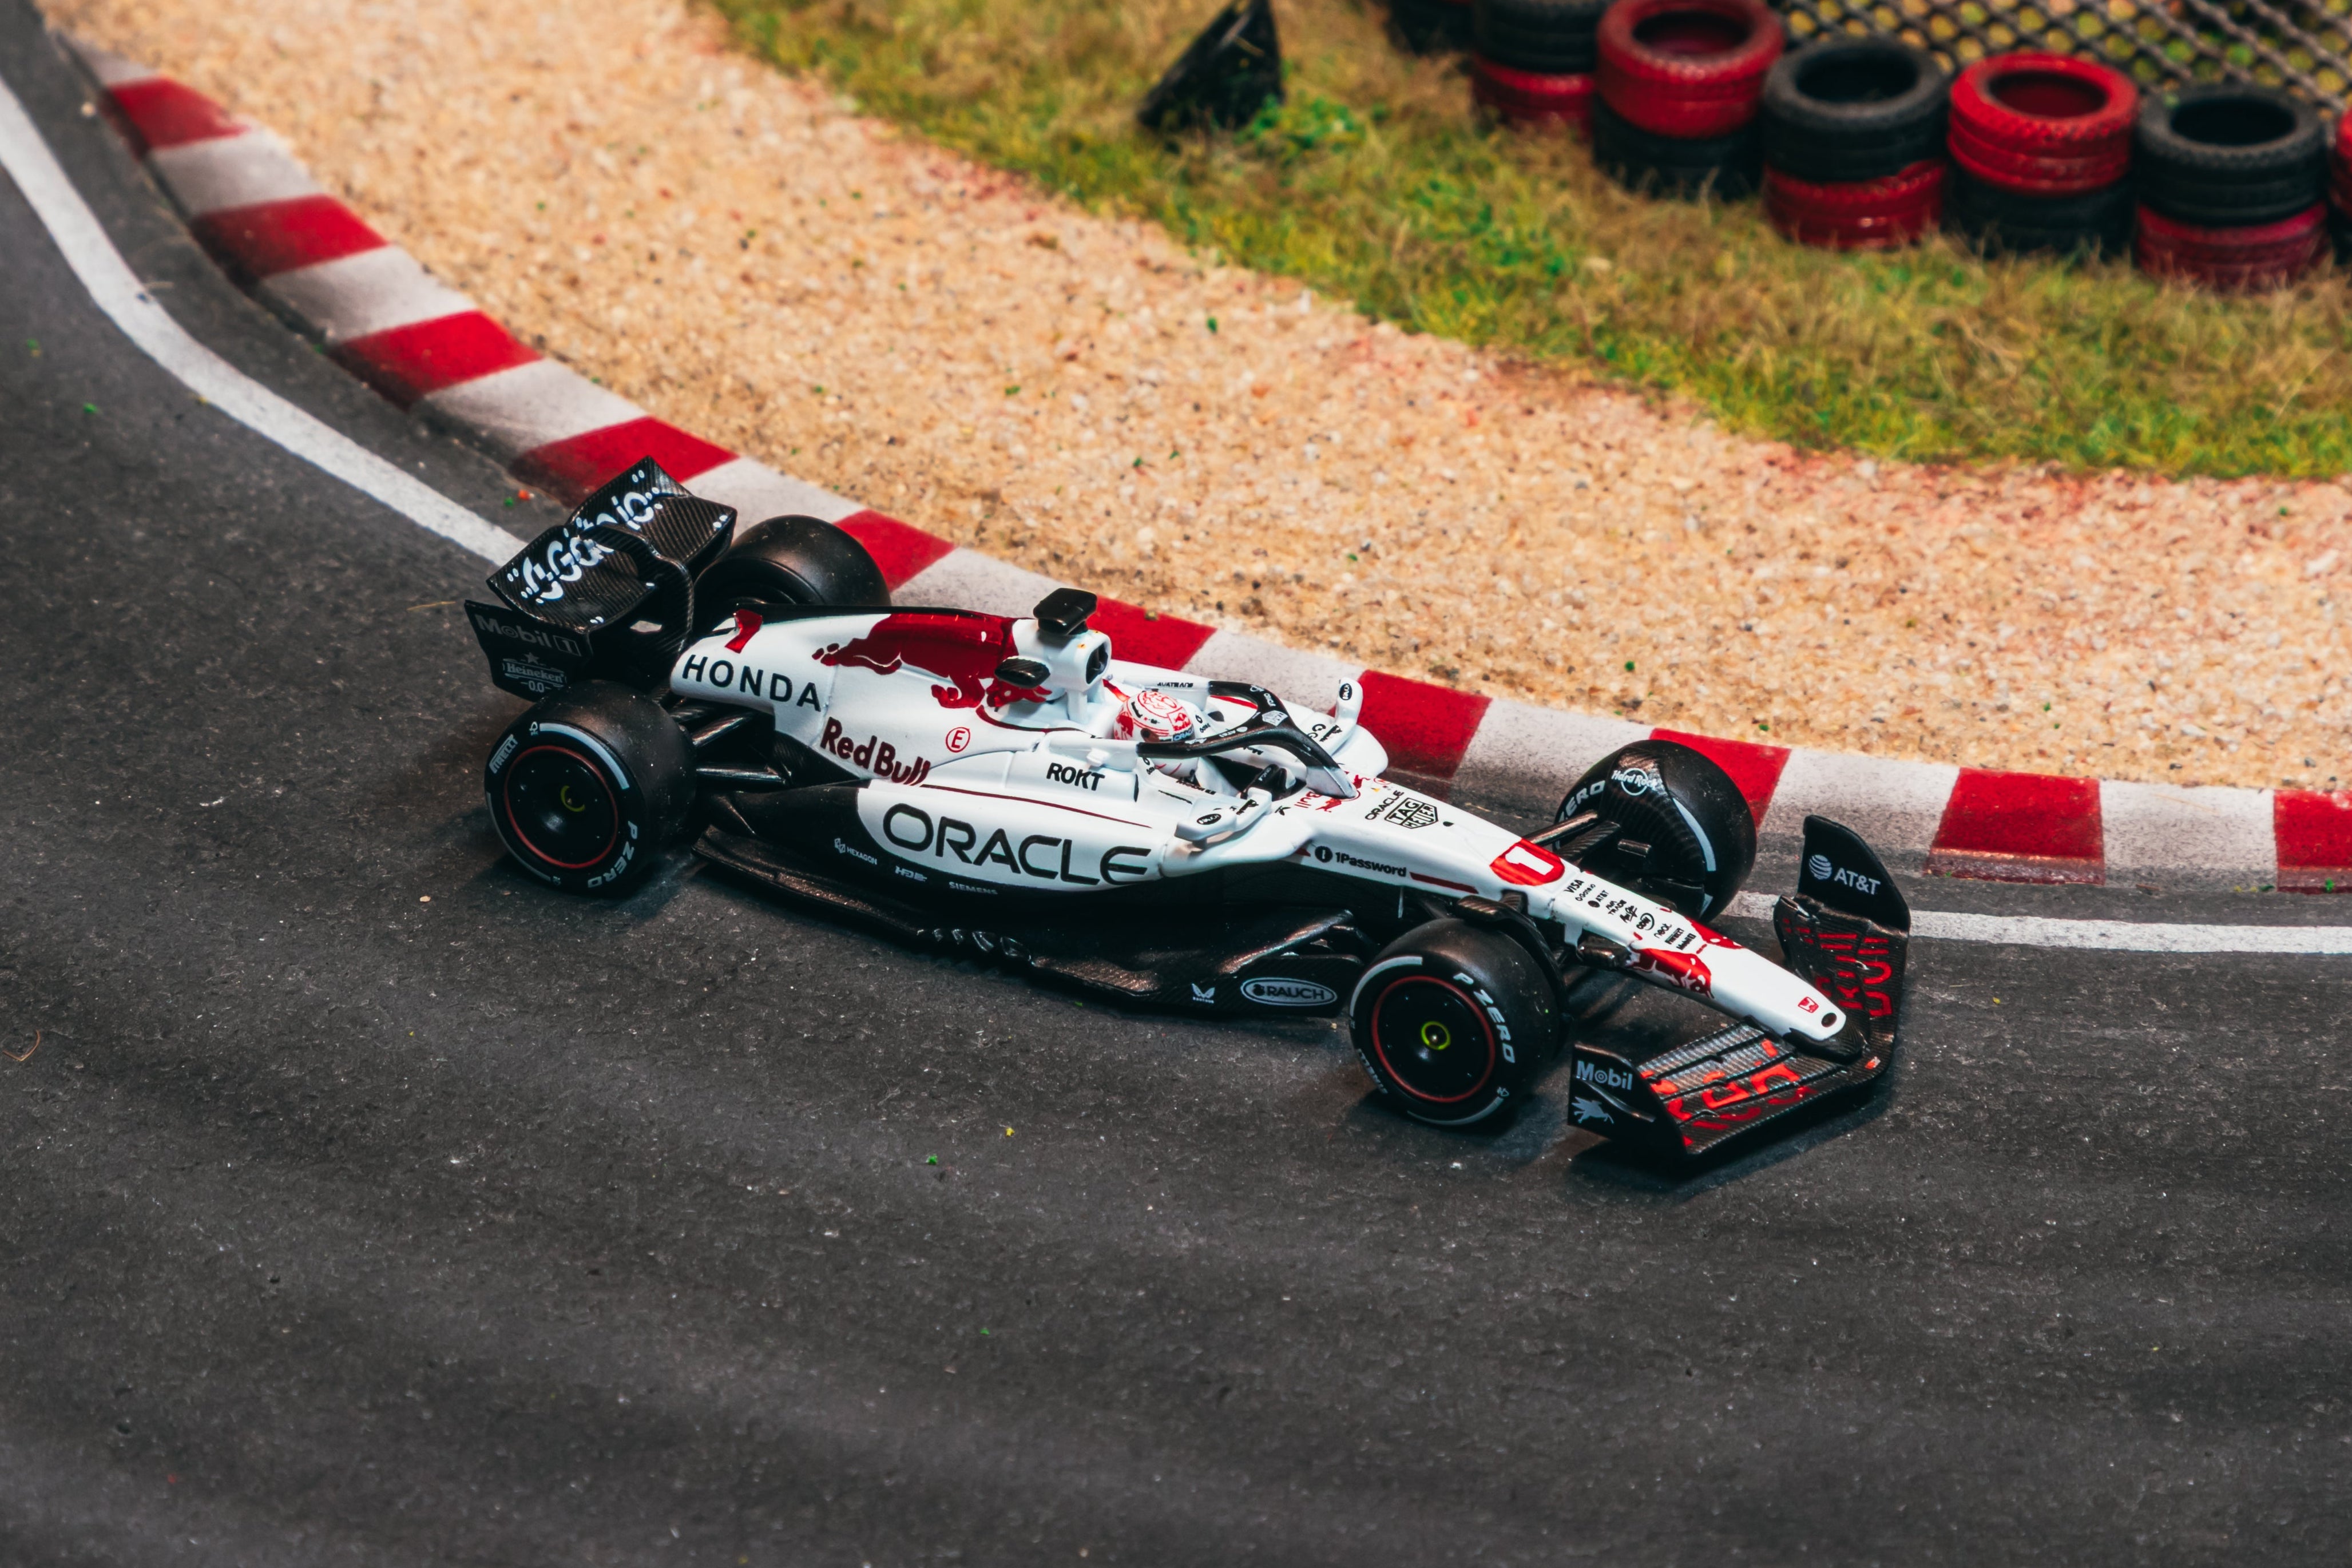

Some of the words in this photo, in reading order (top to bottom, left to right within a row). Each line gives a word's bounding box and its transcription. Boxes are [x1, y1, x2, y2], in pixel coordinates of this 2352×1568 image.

[474, 614, 552, 648] Mobil
[507, 662, 562, 683] Heineken
[528, 680, 544, 693] 0.0
[683, 654, 822, 712] HONDA
[489, 734, 518, 774] PIRELLI
[820, 717, 877, 769] Red
[874, 740, 931, 786] Bull
[1046, 763, 1105, 792] ROKT
[1612, 770, 1635, 783] Hard
[1365, 790, 1405, 820] ORACLE
[1389, 801, 1419, 820] TAG
[628, 820, 638, 840] P
[847, 846, 878, 866] HEXAGON
[883, 803, 1152, 886] ORACLE
[588, 841, 634, 888] ZERO
[1335, 851, 1407, 877] 1Password
[1505, 845, 1554, 875] 1
[949, 882, 998, 895] SIEMENS
[1563, 879, 1585, 893] VISA
[1834, 867, 1881, 895] AT&T
[1267, 985, 1324, 1000] RAUCH
[1453, 972, 1474, 985] P
[1473, 989, 1516, 1063] ZERO
[1576, 1060, 1632, 1090] Mobil
